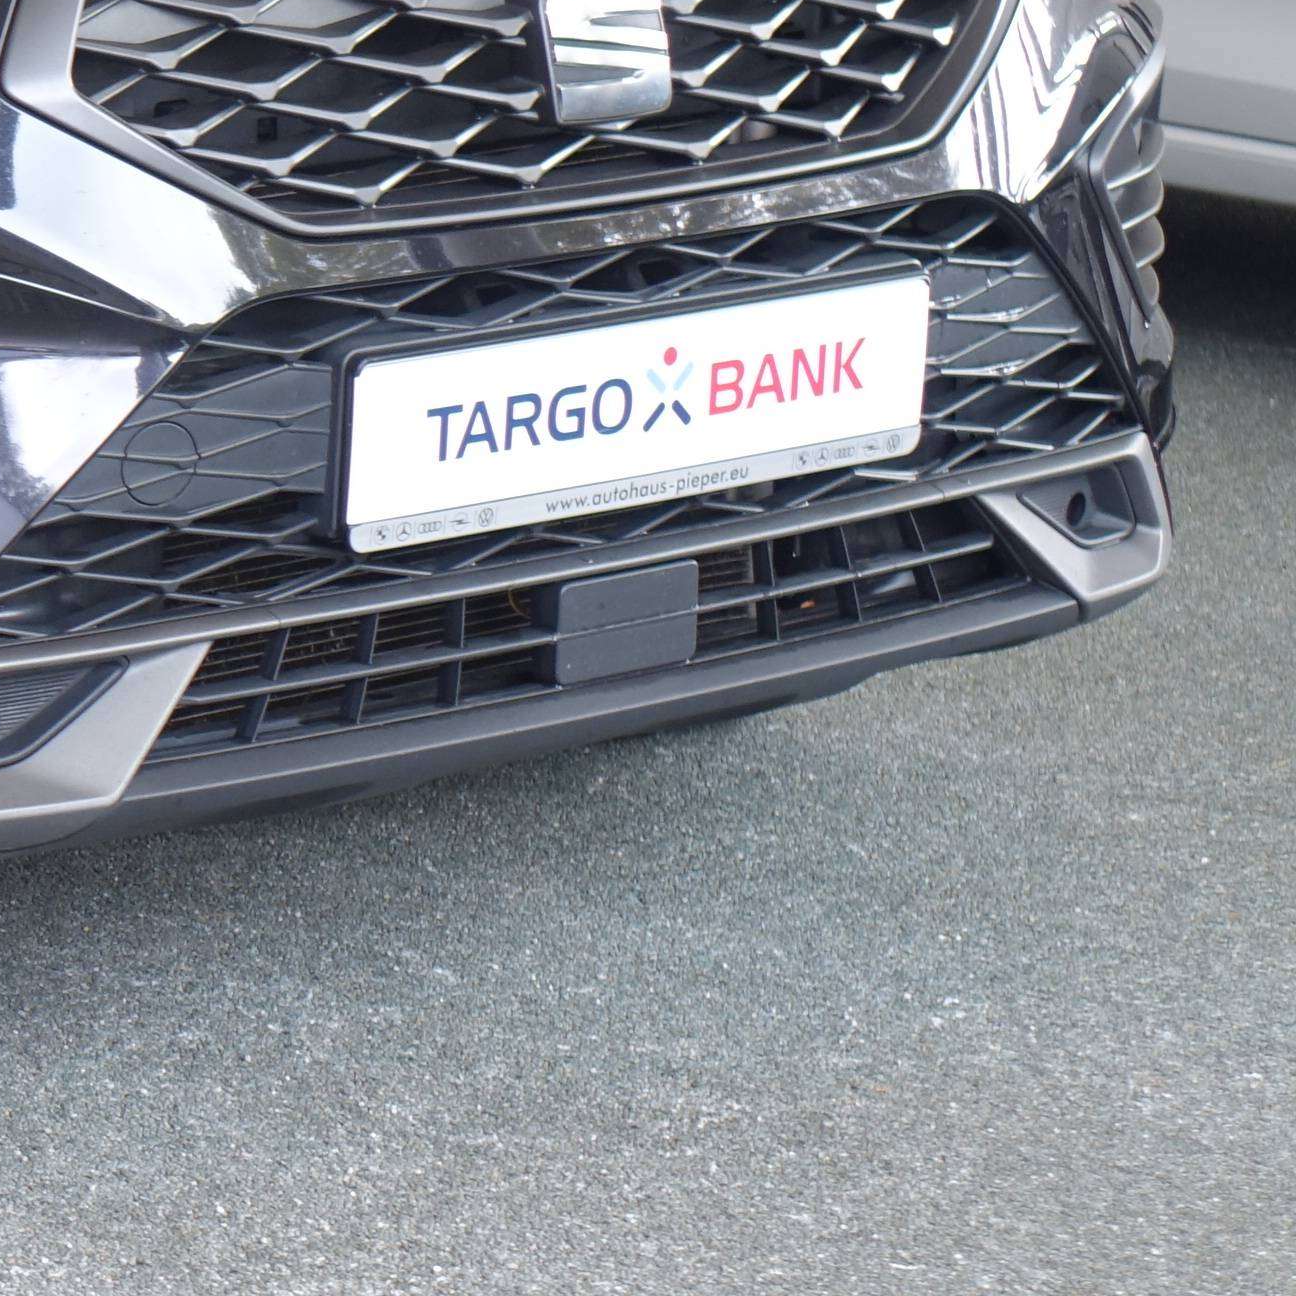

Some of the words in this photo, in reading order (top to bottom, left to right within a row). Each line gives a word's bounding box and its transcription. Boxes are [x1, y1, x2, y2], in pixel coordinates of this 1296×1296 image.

[428, 378, 632, 462] TARGO
[709, 338, 866, 416] BANK
[545, 465, 749, 513] www.autohaus-pieper.eu
